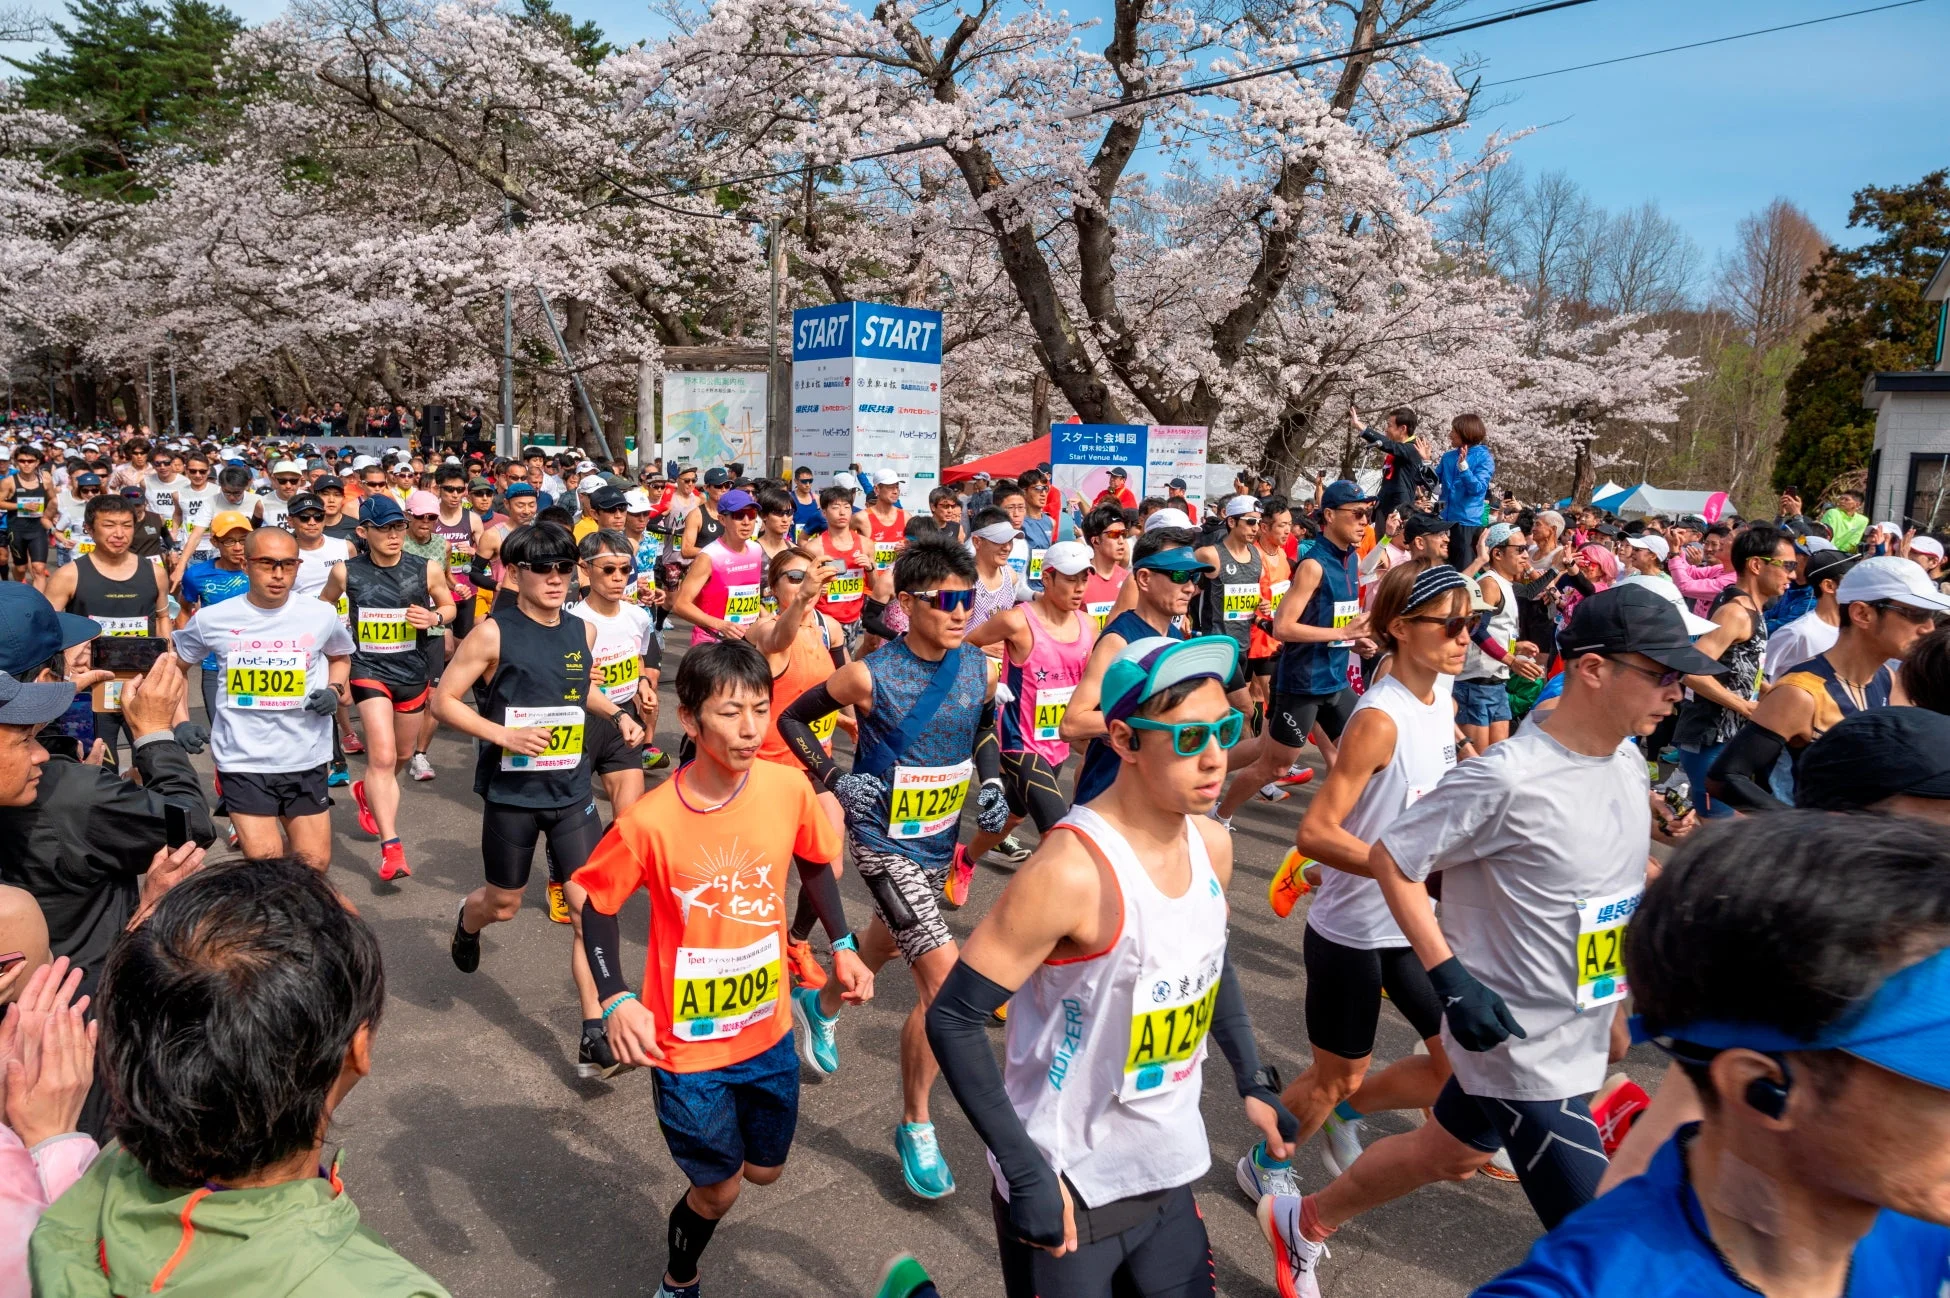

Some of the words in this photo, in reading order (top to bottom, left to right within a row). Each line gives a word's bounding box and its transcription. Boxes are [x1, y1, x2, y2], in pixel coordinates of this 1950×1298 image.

[797, 315, 849, 350] START
[861, 315, 936, 351] START
[795, 404, 819, 413] 県民共済
[858, 404, 895, 414] 県民共済
[1061, 432, 1137, 444] スタート会場図
[1112, 454, 1128, 462] Map
[829, 579, 859, 593] A1056
[728, 597, 758, 613] A2226
[1226, 595, 1255, 610] A1562
[109, 620, 143, 629] 東奥日報
[362, 622, 407, 640] A1211
[600, 659, 633, 684] 2519
[232, 670, 294, 693] A1302
[514, 710, 527, 718] ipet
[911, 769, 969, 783] カクヒログループ
[896, 784, 960, 818] A1229
[728, 893, 776, 917] たび
[688, 954, 706, 965] ipet
[680, 967, 770, 1016] A1209
[1134, 984, 1215, 1064] A129
[1048, 999, 1082, 1092] ADIZERO
